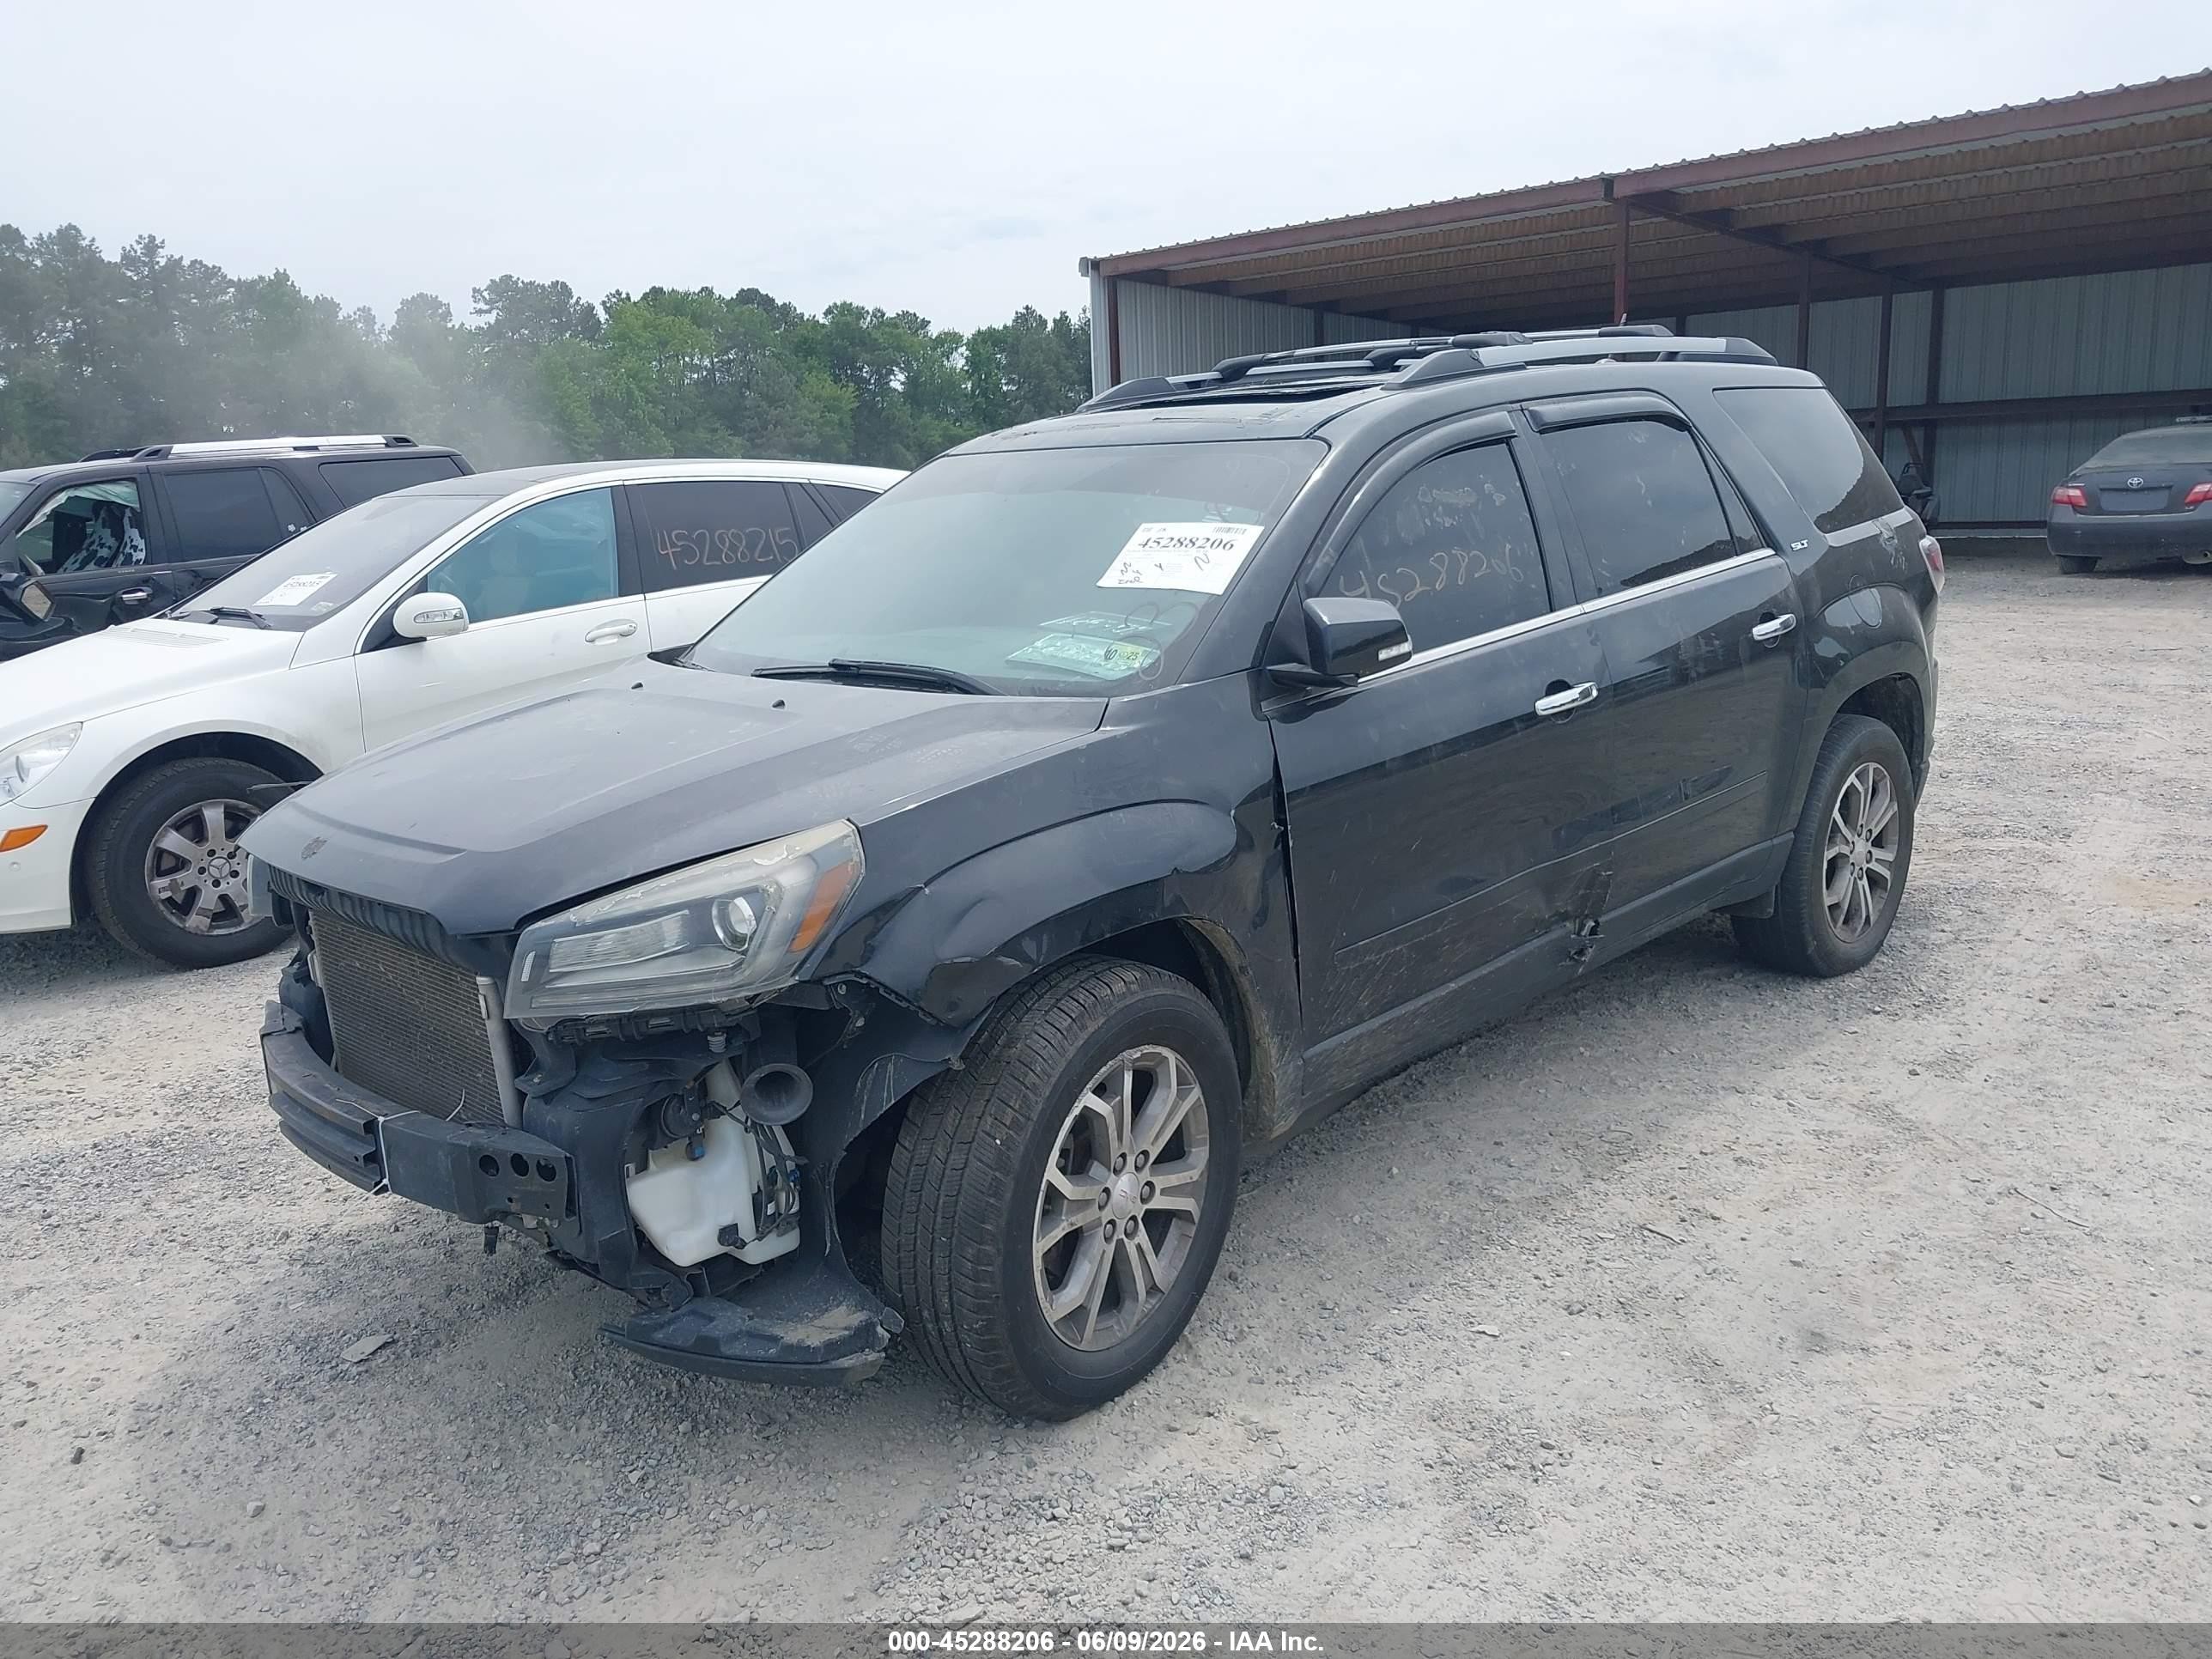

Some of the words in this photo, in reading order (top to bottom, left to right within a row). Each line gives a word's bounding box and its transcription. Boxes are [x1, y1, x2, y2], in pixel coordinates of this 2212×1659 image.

[658, 527, 799, 570] 45288215
[1138, 537, 1237, 551] 45288206
[1790, 539, 1808, 551] SLT
